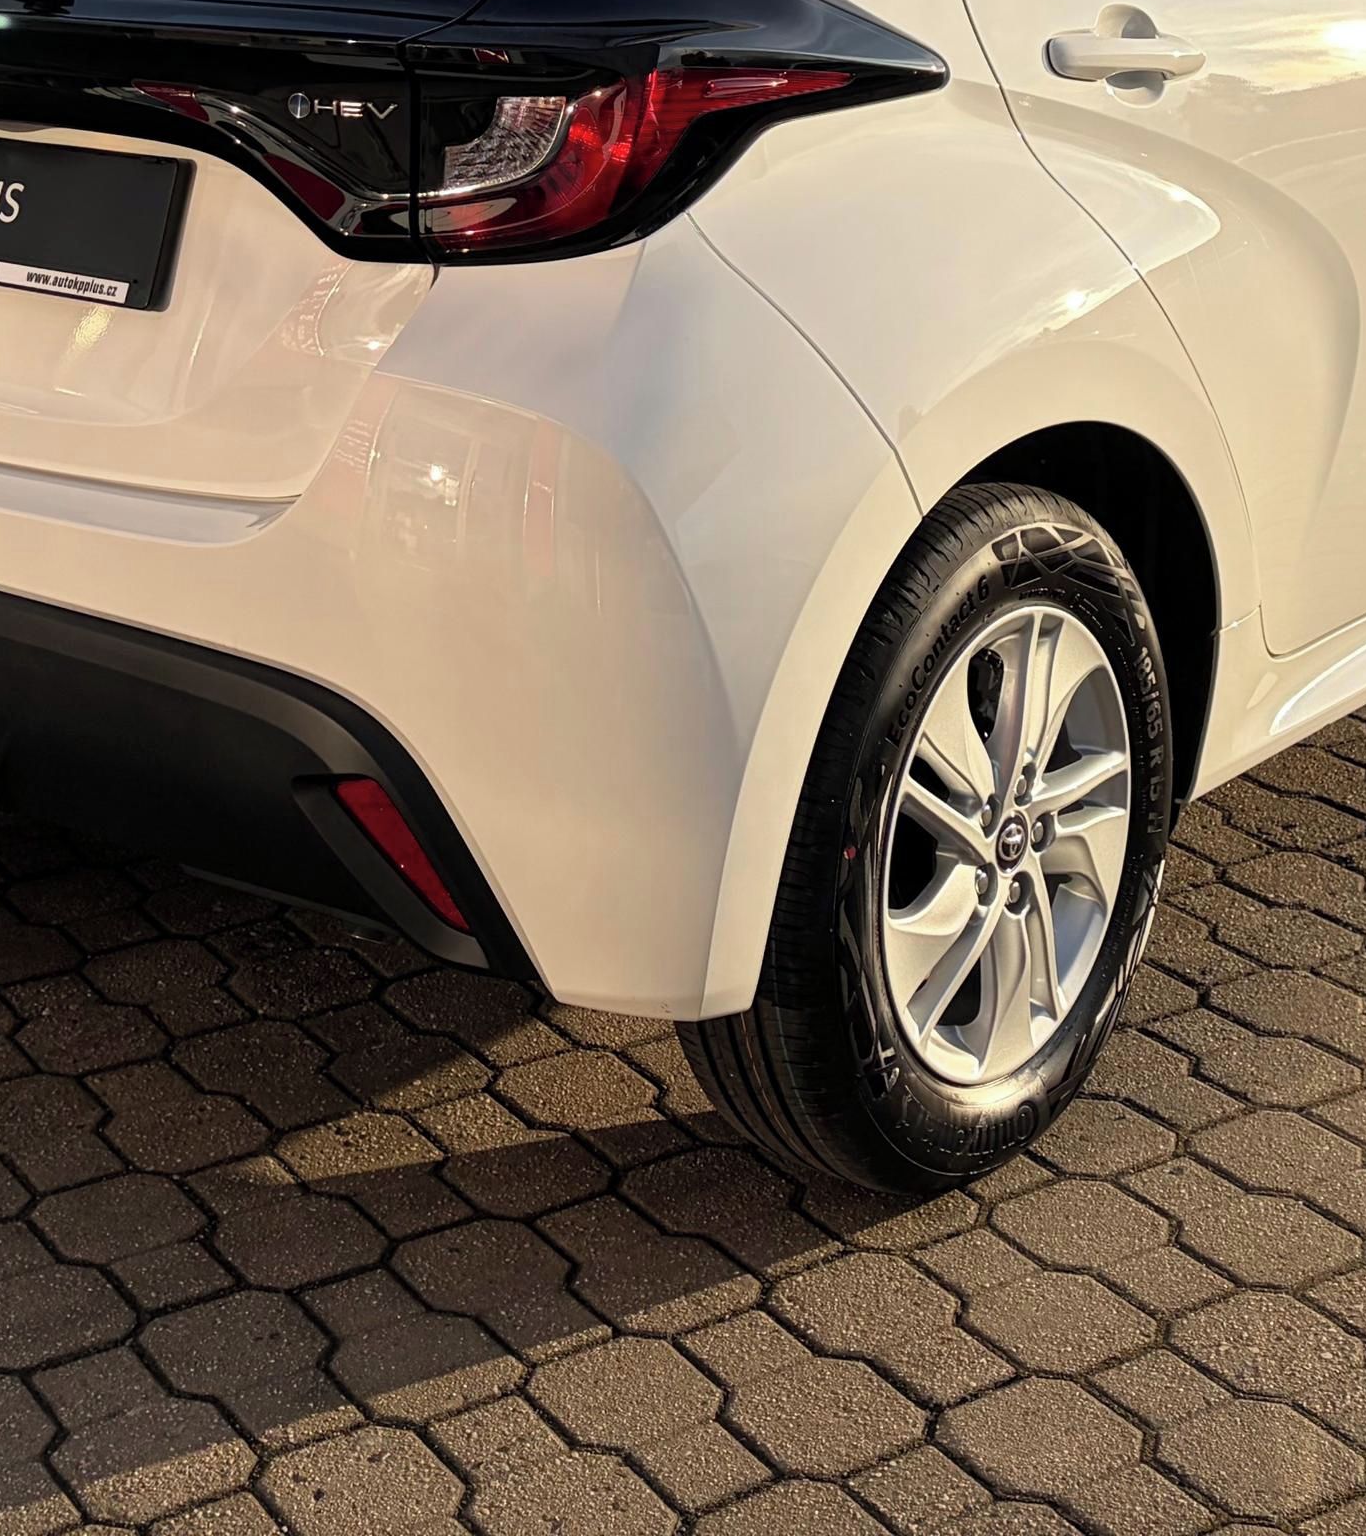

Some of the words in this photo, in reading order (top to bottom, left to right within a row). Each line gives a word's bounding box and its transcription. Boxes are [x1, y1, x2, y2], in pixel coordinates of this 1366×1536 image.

[314, 98, 399, 120] HEV
[26, 271, 119, 297] www.autokpplus.cz
[887, 590, 979, 748] EcoContact
[977, 574, 990, 603] 6
[1134, 645, 1164, 740] 185/65
